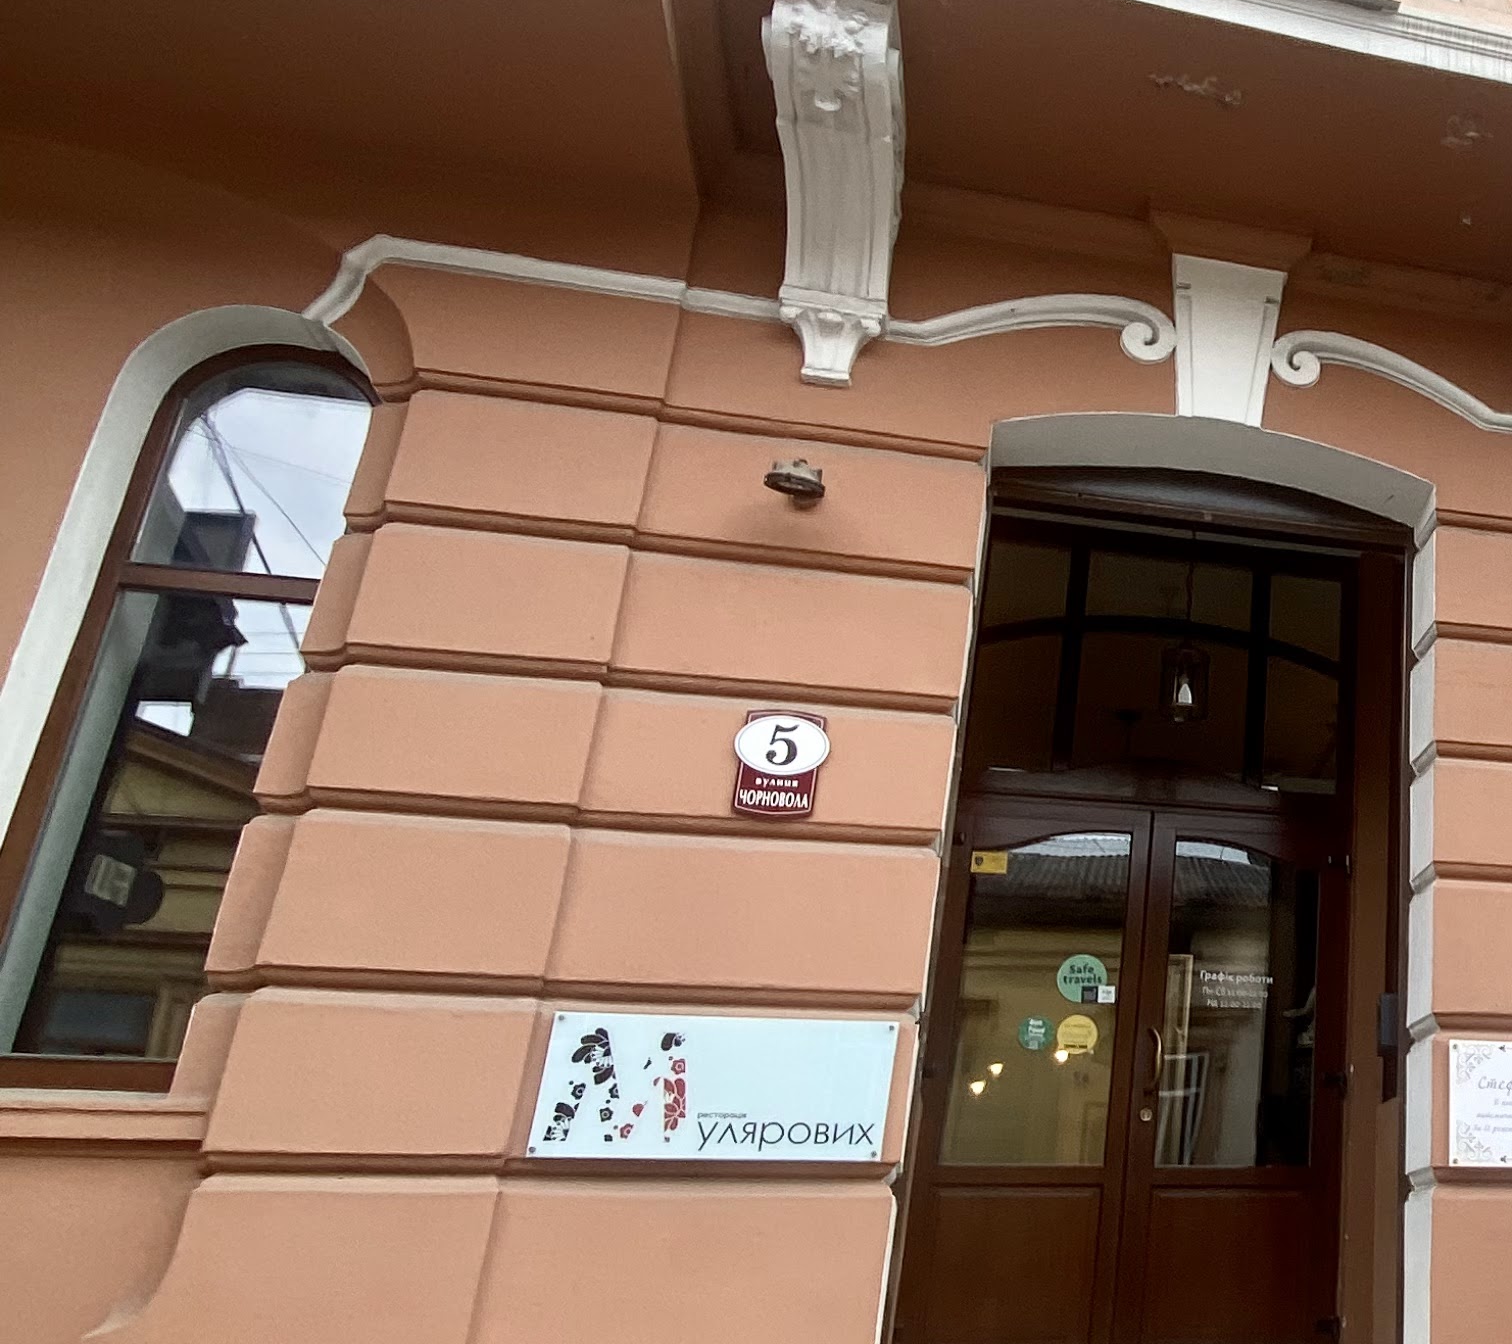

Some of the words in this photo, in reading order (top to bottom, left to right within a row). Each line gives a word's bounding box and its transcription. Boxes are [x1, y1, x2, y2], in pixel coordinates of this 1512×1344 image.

[766, 724, 799, 766] 5
[740, 788, 808, 809] ЧОРНОВОЛА
[1069, 963, 1094, 974] Safe
[1063, 975, 1102, 985] travels
[1235, 973, 1274, 984] роботи
